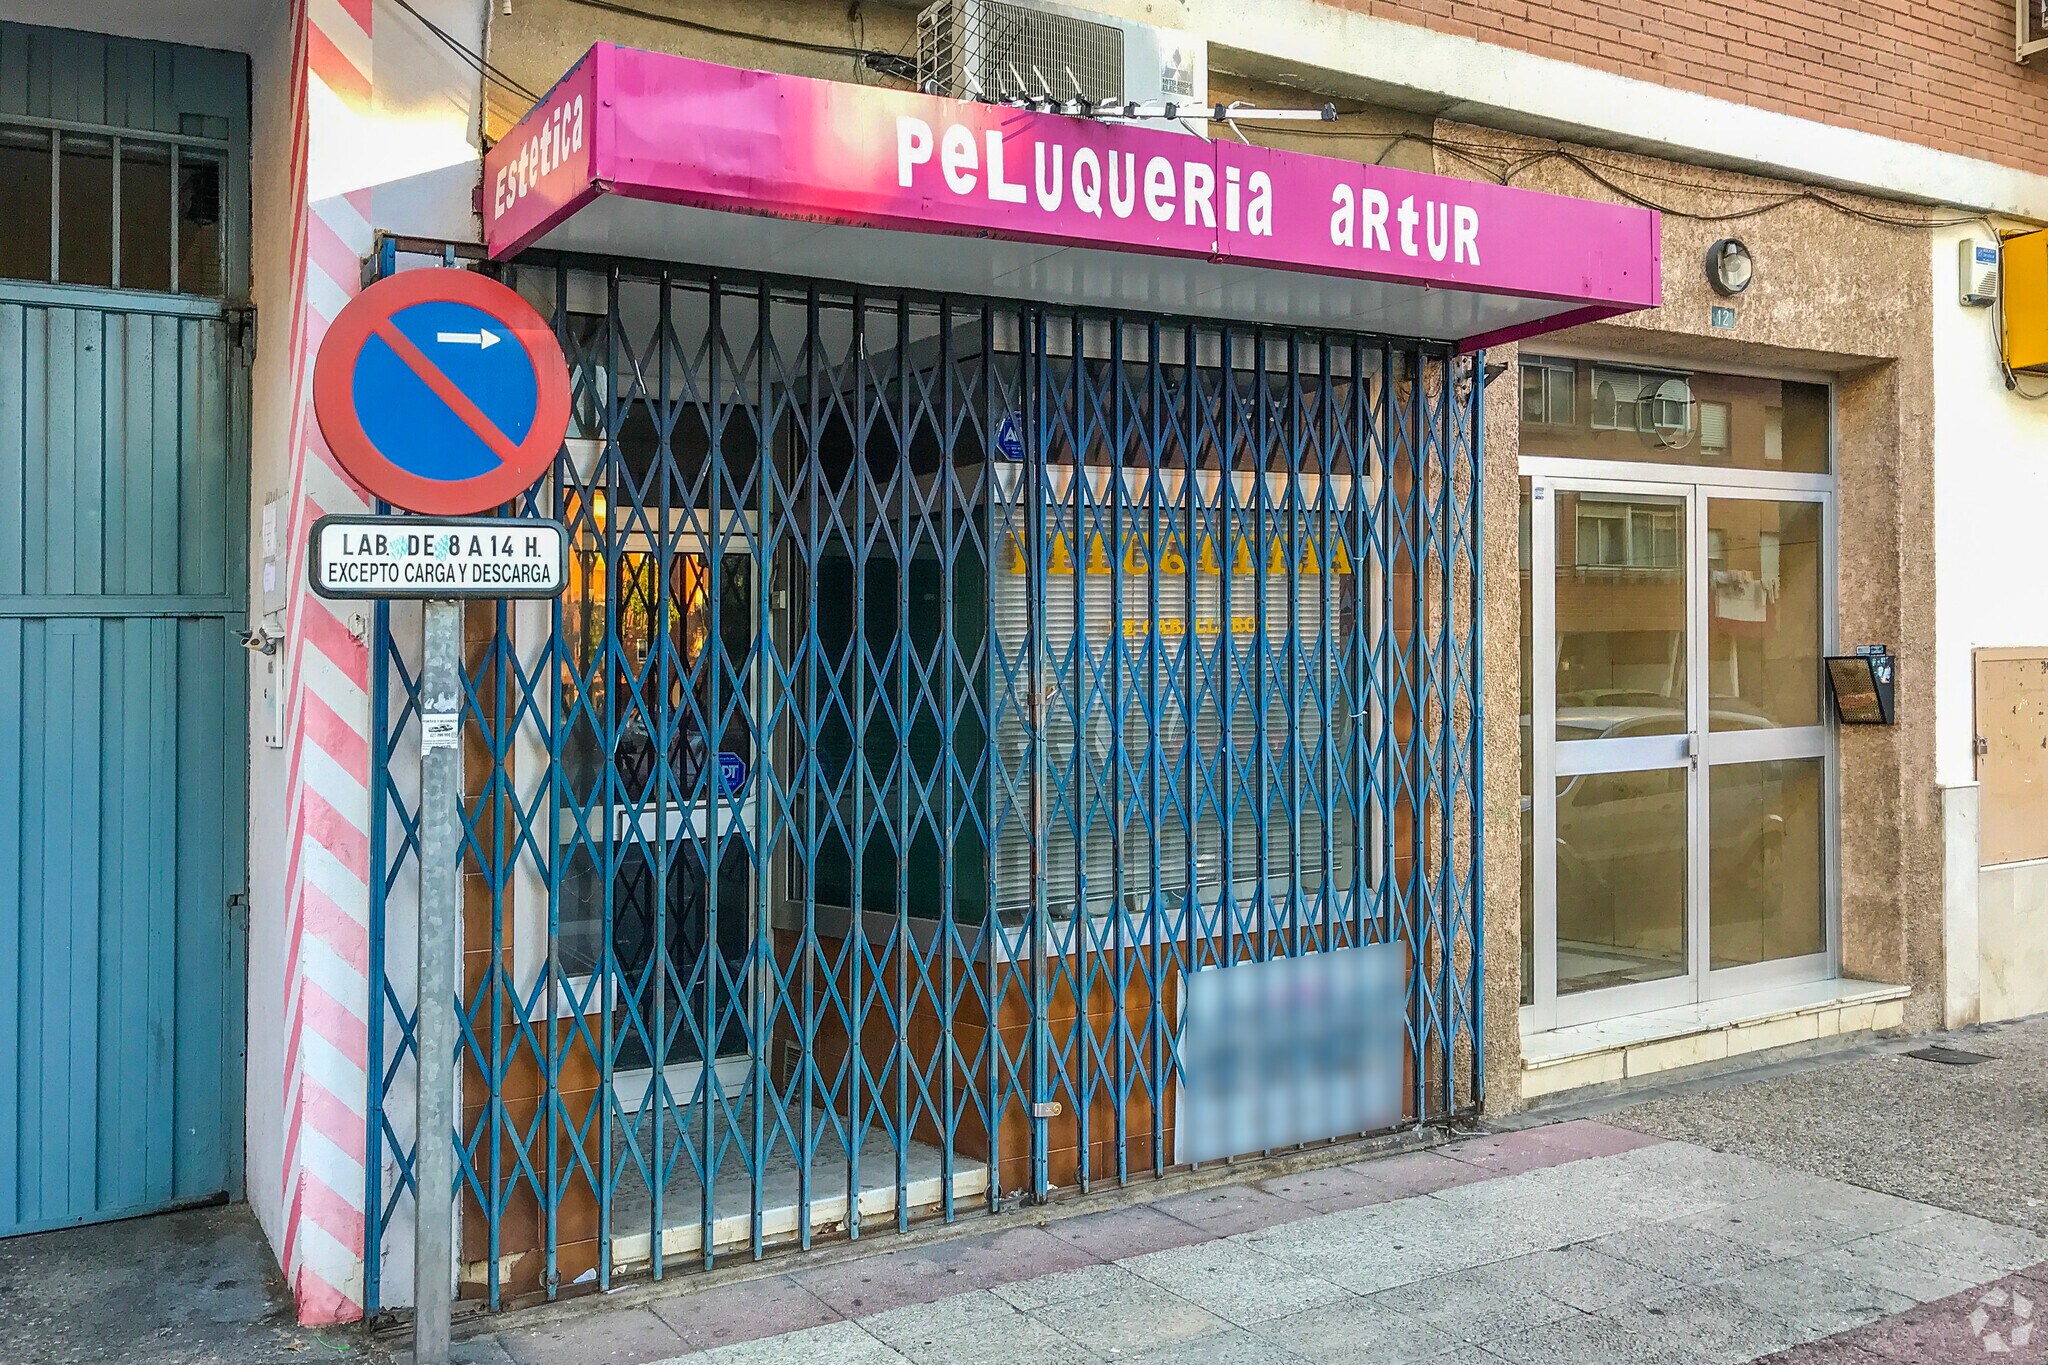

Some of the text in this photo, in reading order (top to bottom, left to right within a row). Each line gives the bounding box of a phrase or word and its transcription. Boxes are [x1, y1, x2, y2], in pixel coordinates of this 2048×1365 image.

[494, 94, 583, 221] Estetica
[1717, 309, 1730, 327] 12
[343, 534, 390, 556] LAB.
[408, 534, 434, 556] DE
[449, 534, 460, 556] 8
[468, 535, 482, 556] A
[491, 536, 514, 557] 14
[525, 536, 541, 557] H.
[328, 562, 551, 583] EXCEPTO CARGA Y DESCARGA
[1109, 619, 1137, 636] E
